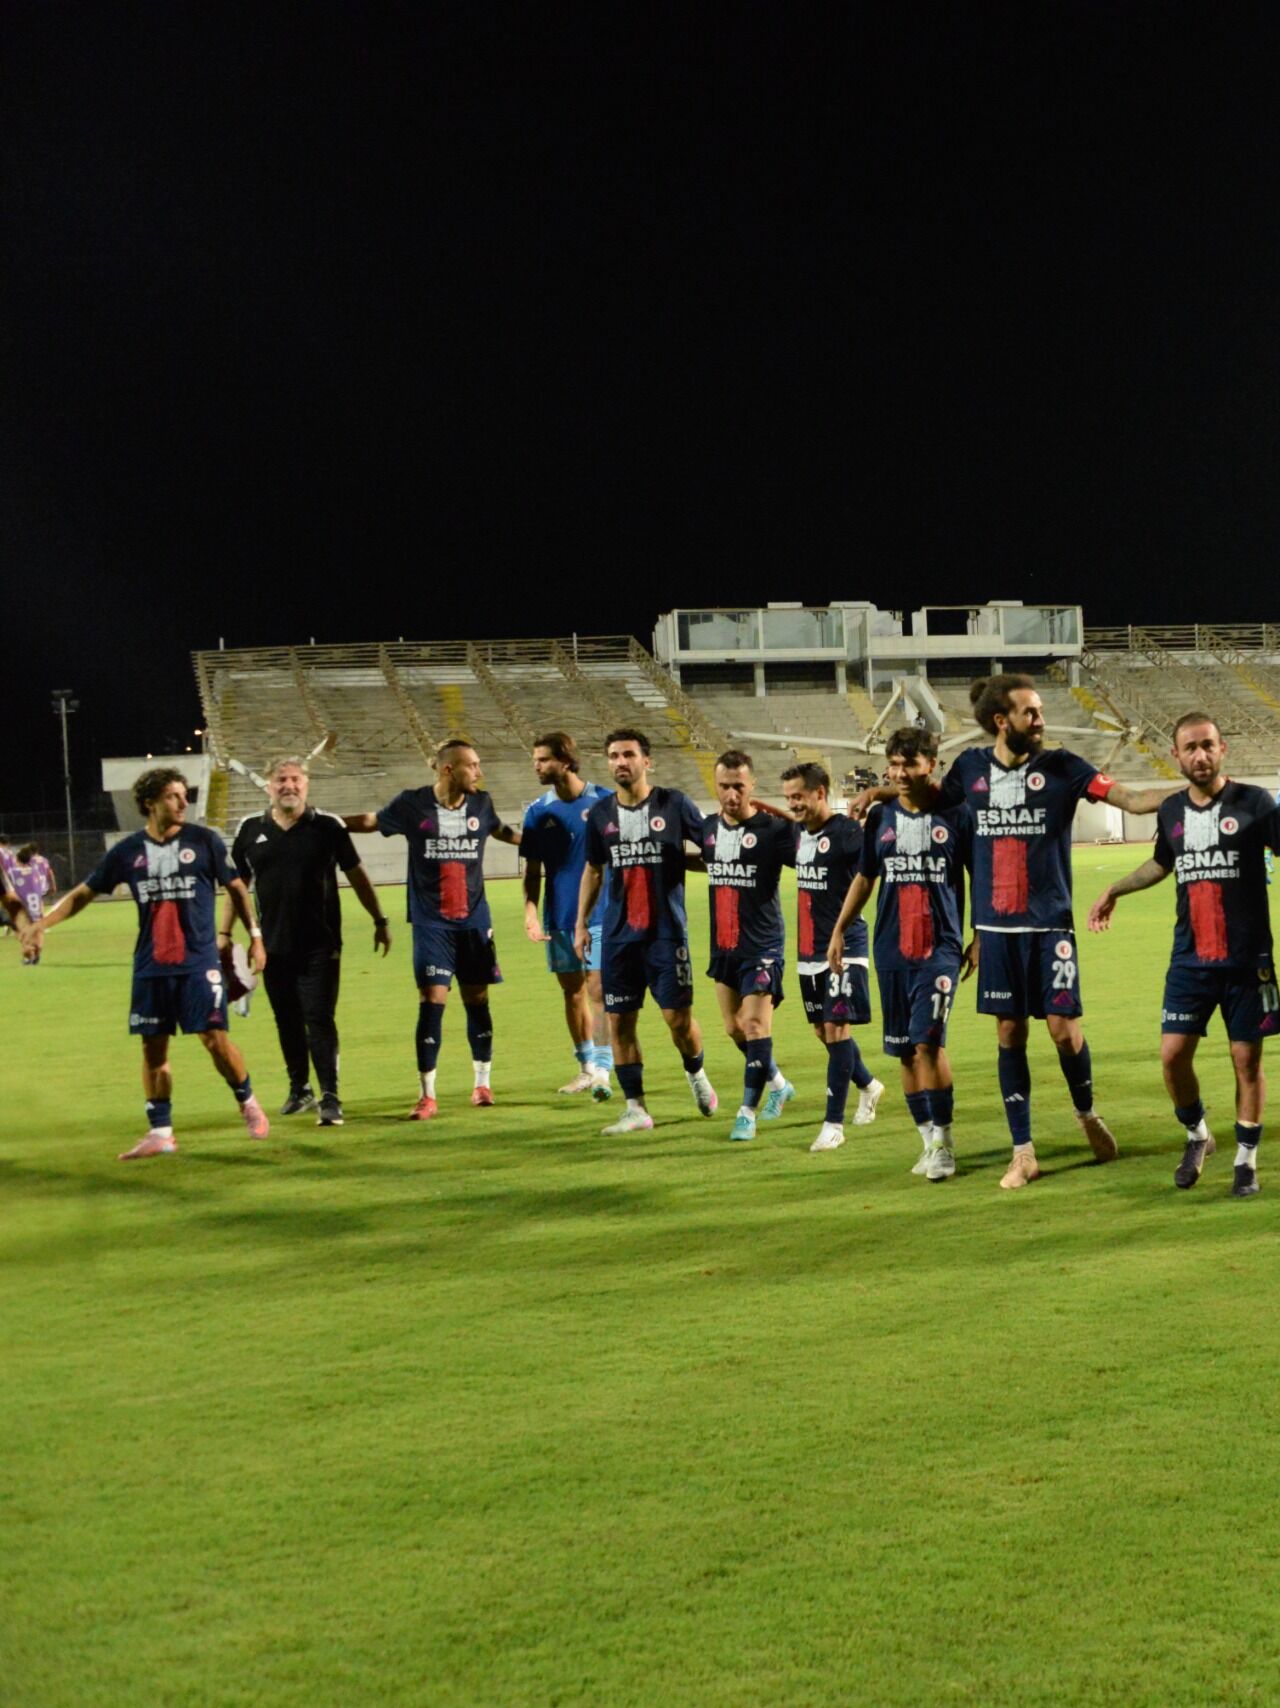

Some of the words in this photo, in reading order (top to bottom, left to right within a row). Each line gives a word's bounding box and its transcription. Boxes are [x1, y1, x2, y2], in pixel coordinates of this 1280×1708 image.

[976, 808, 1046, 825] ESNAF
[425, 838, 479, 851] ESNAF
[610, 841, 664, 858] ESNAF
[612, 856, 664, 868] HASTANES
[885, 856, 946, 872] ESNAF
[1175, 850, 1239, 871] ESNAF
[707, 863, 757, 878] ESNAF
[796, 865, 828, 880] NAF
[136, 876, 197, 893] ESNAF
[27, 893, 40, 912] 8
[1051, 960, 1076, 990] 29
[829, 971, 853, 998] 34
[211, 984, 223, 1009] 7
[990, 991, 1013, 1000] GRUP
[1257, 983, 1279, 1013] 10
[1167, 1012, 1177, 1022] US
